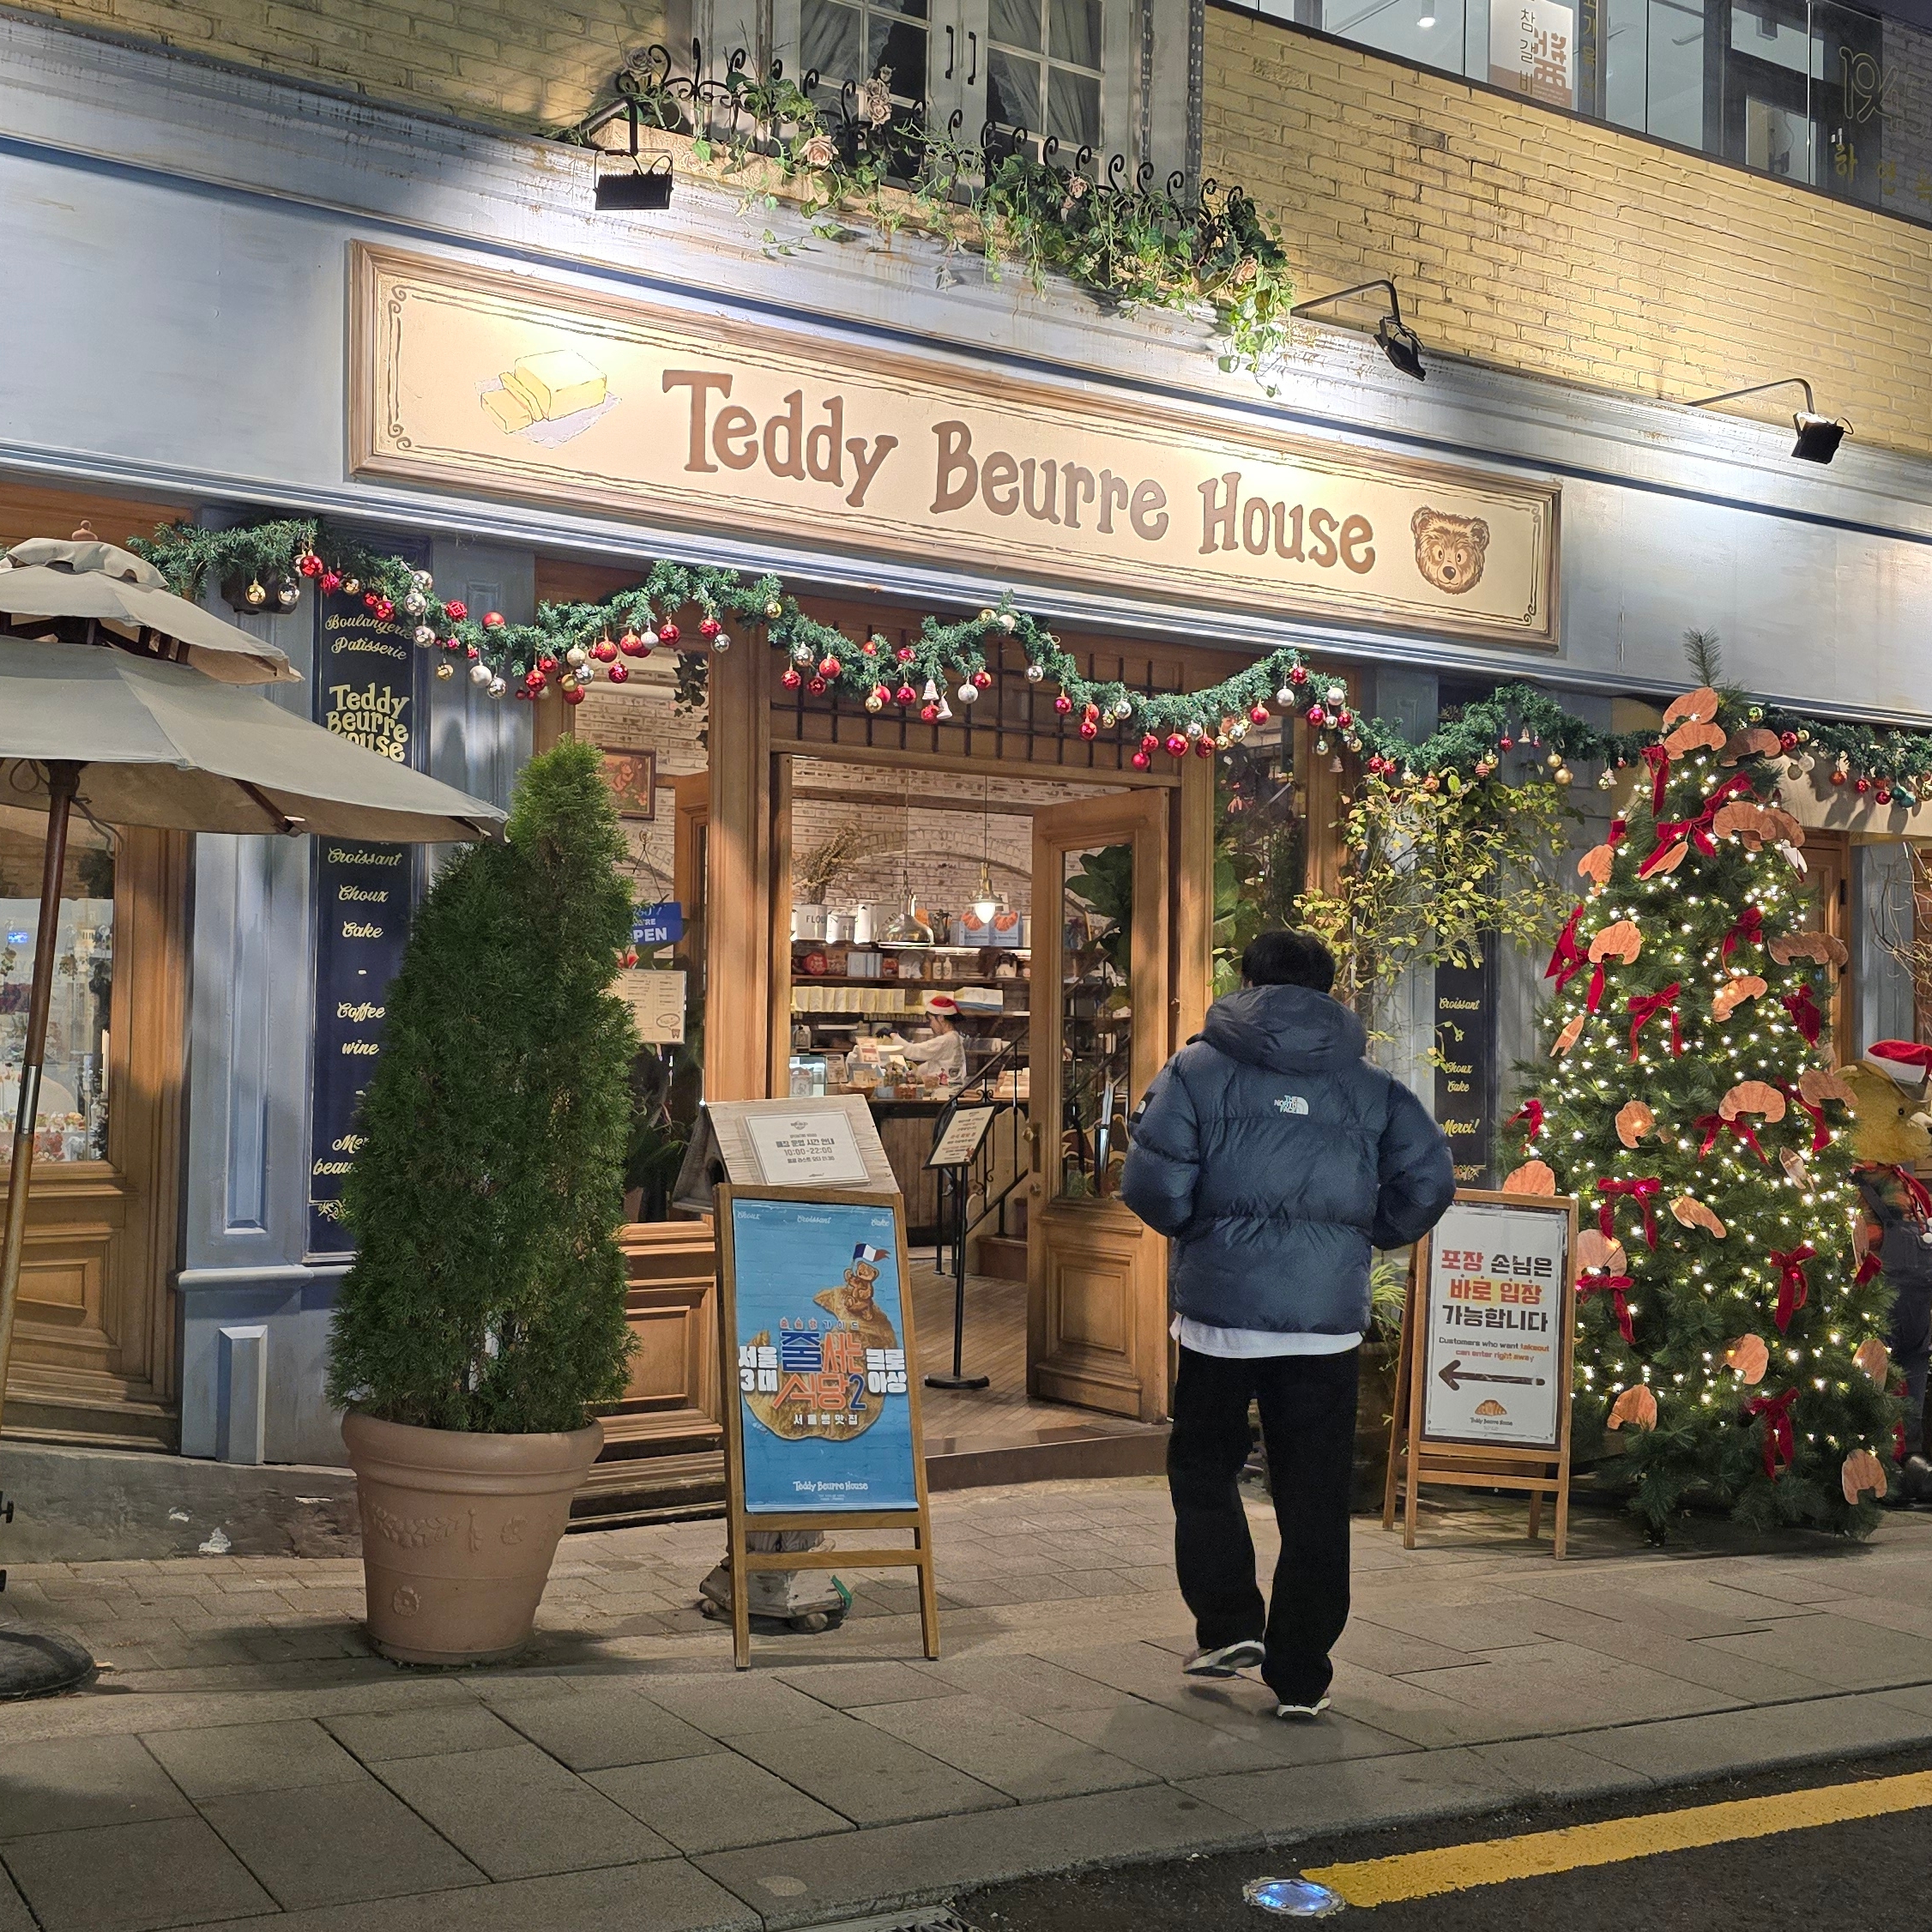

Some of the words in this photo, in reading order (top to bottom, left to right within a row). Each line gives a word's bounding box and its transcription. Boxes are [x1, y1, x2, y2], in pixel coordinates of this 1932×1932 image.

[1519, 0, 1536, 95] 참갈비
[662, 370, 898, 508] Teddy
[930, 420, 1169, 541] Beurre
[1198, 472, 1376, 574] House
[325, 613, 414, 640] Boulangerie
[331, 637, 408, 661] Patisserie
[329, 682, 410, 719] Teddy
[326, 711, 409, 743] Beurre
[338, 732, 406, 762] ouse
[328, 847, 402, 866] Croissant
[338, 884, 389, 903] Choux
[342, 921, 384, 938] Cake
[632, 927, 667, 943] PEN
[337, 1002, 386, 1022] Coffee
[1439, 997, 1481, 1011] Croissant
[341, 1040, 380, 1055] wine
[1446, 1061, 1473, 1073] Choux
[1447, 1080, 1470, 1093] Cake
[1439, 1118, 1481, 1138] Merci!
[797, 1214, 832, 1224] Croissant
[871, 1217, 890, 1227] Cake
[1441, 1249, 1484, 1272] 포장
[1491, 1253, 1553, 1278] 손님은
[1450, 1278, 1492, 1301] 바로
[1500, 1282, 1543, 1305] 입장
[1442, 1305, 1549, 1332] 가능합니다
[1439, 1337, 1481, 1347] Customers
[1520, 1343, 1550, 1352] takeout
[738, 1345, 778, 1368] 서울
[866, 1348, 905, 1371] 크로
[1471, 1349, 1493, 1358] enter
[1494, 1351, 1512, 1361] right
[1513, 1354, 1535, 1363] away
[740, 1368, 778, 1392] 3대
[867, 1371, 908, 1393] 아상
[793, 1481, 816, 1492] Teddy
[845, 1481, 869, 1491] House
